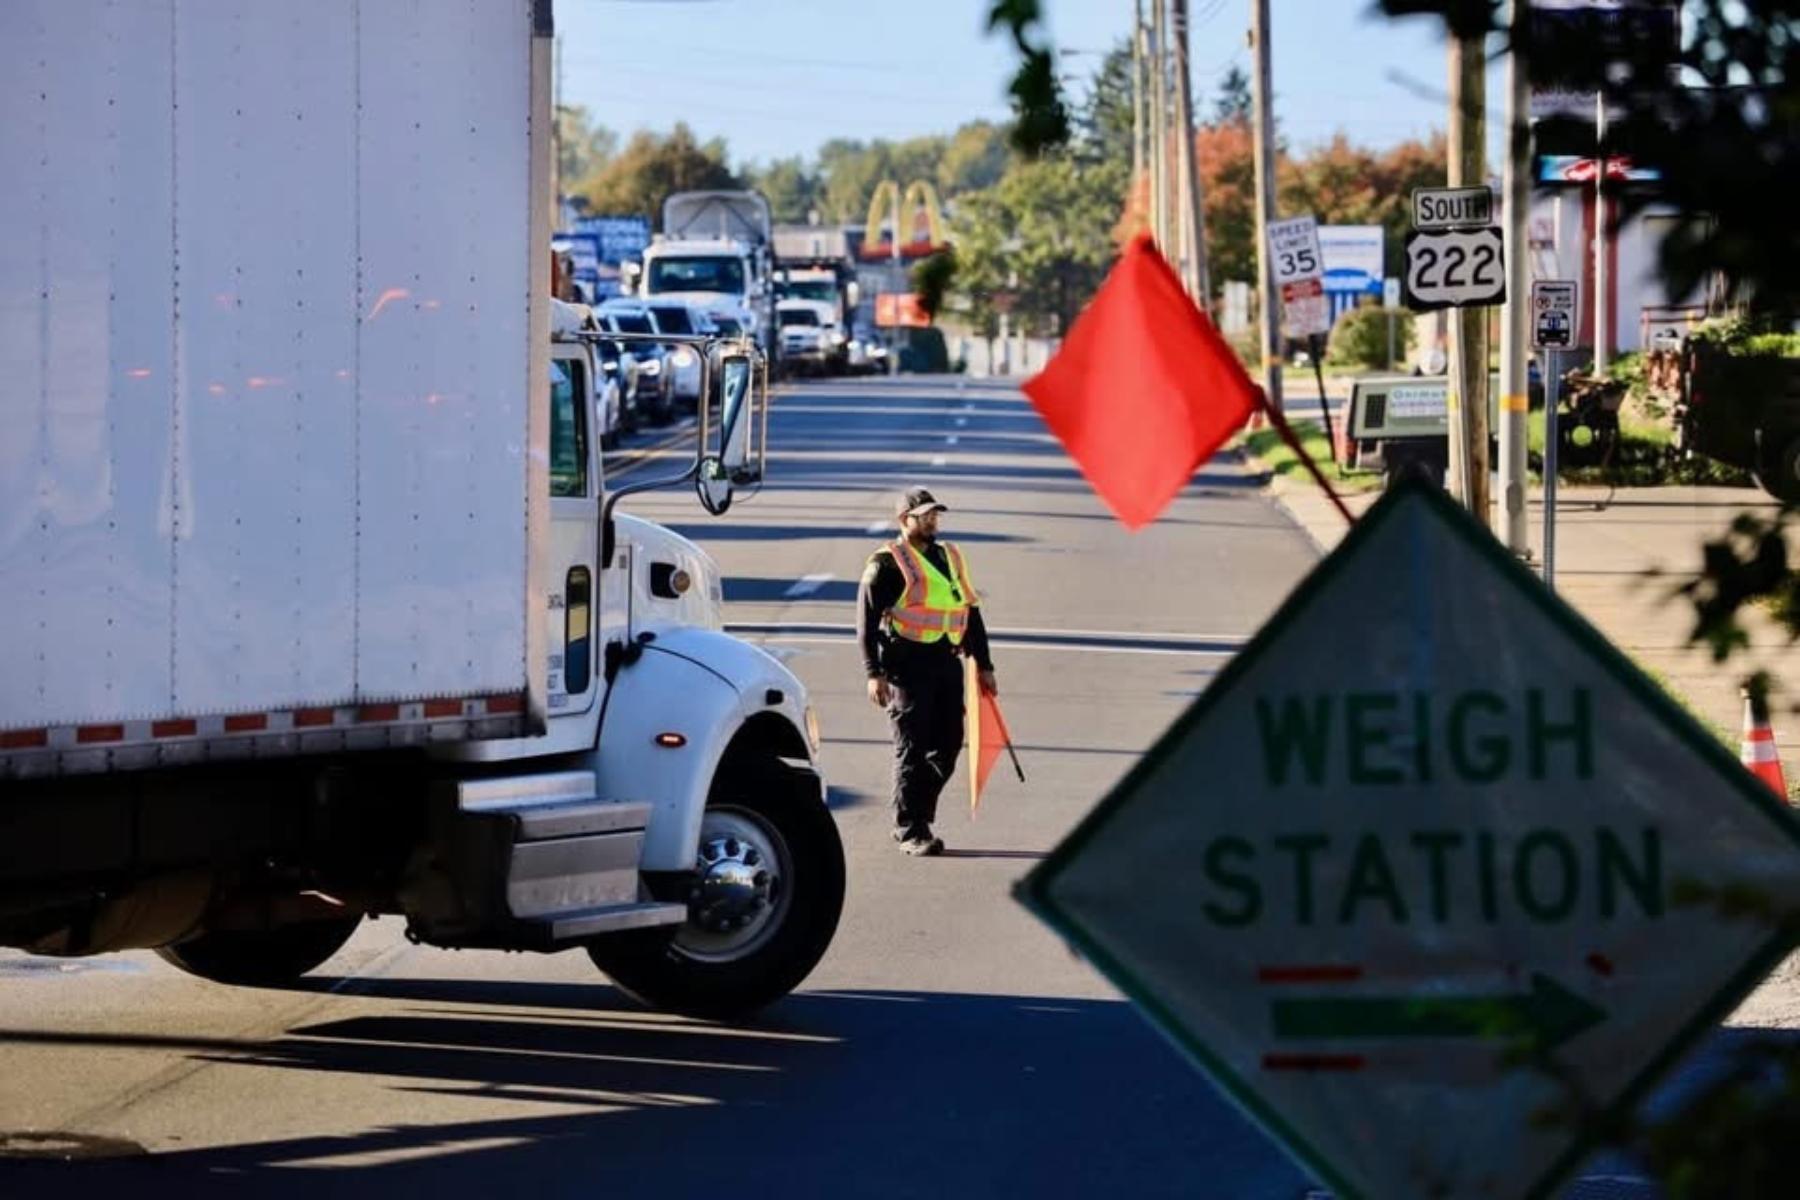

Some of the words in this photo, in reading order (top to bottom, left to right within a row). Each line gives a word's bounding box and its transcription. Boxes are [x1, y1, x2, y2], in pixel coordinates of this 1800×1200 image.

[1421, 195, 1488, 221] SOUTH
[1269, 221, 1313, 239] SPEED
[1276, 235, 1309, 251] LIMIT
[1280, 248, 1317, 276] 35
[1415, 244, 1495, 289] 222
[1255, 686, 1595, 786] WEIGH
[1200, 826, 1666, 928] STATION
